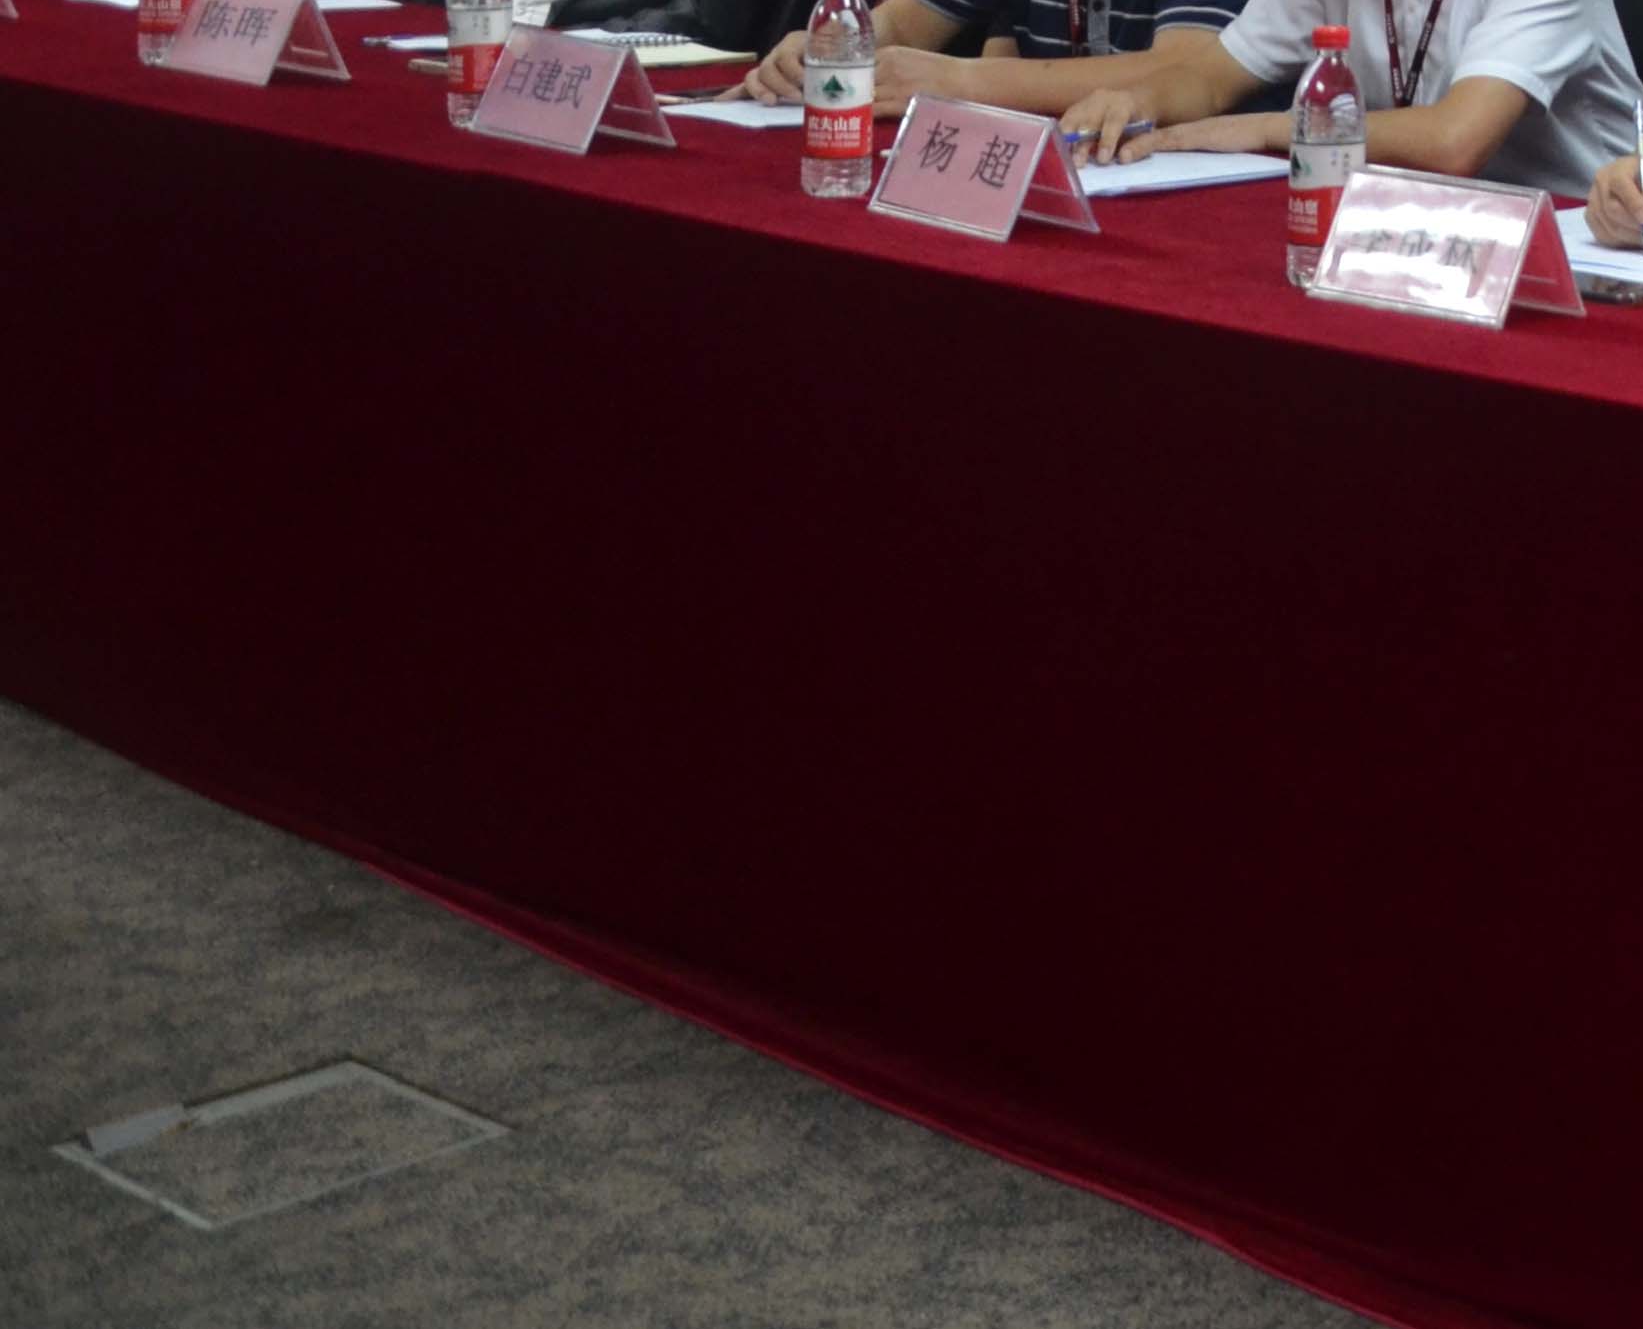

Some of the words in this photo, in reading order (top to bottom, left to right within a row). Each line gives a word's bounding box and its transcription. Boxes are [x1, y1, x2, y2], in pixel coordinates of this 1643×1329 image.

[192, 0, 279, 47] 陈晖
[502, 52, 593, 110] 白建武
[808, 115, 862, 132] 农夫山泉
[917, 120, 1022, 189] 杨超
